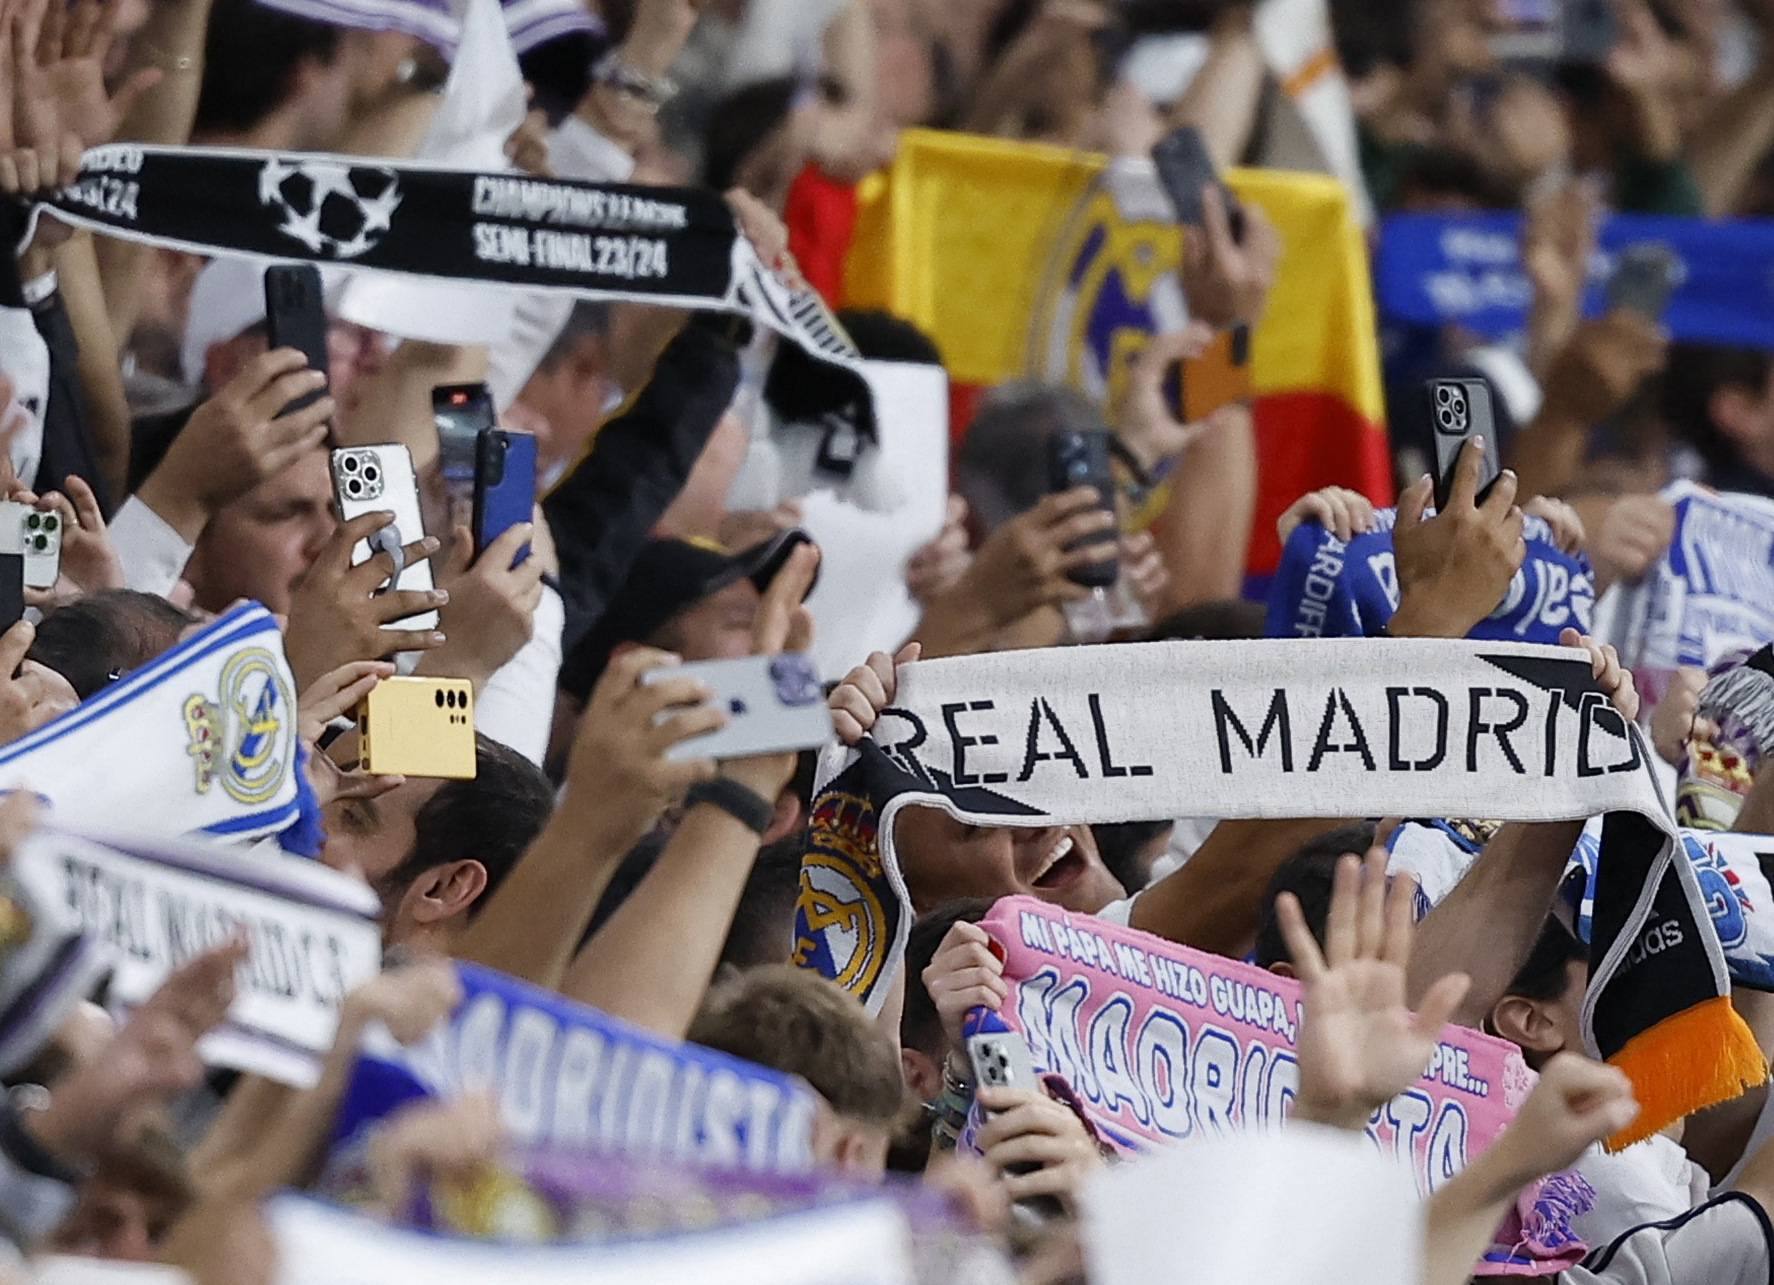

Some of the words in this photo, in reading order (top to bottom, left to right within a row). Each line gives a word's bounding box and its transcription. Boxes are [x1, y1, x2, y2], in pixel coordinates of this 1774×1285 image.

[877, 690, 1154, 788] REAL
[1210, 684, 1642, 780] MADRID
[1020, 910, 1050, 954] MI
[1113, 942, 1153, 989] ME
[1150, 954, 1209, 1008] HIZO
[1210, 972, 1297, 1040] GUAPA,
